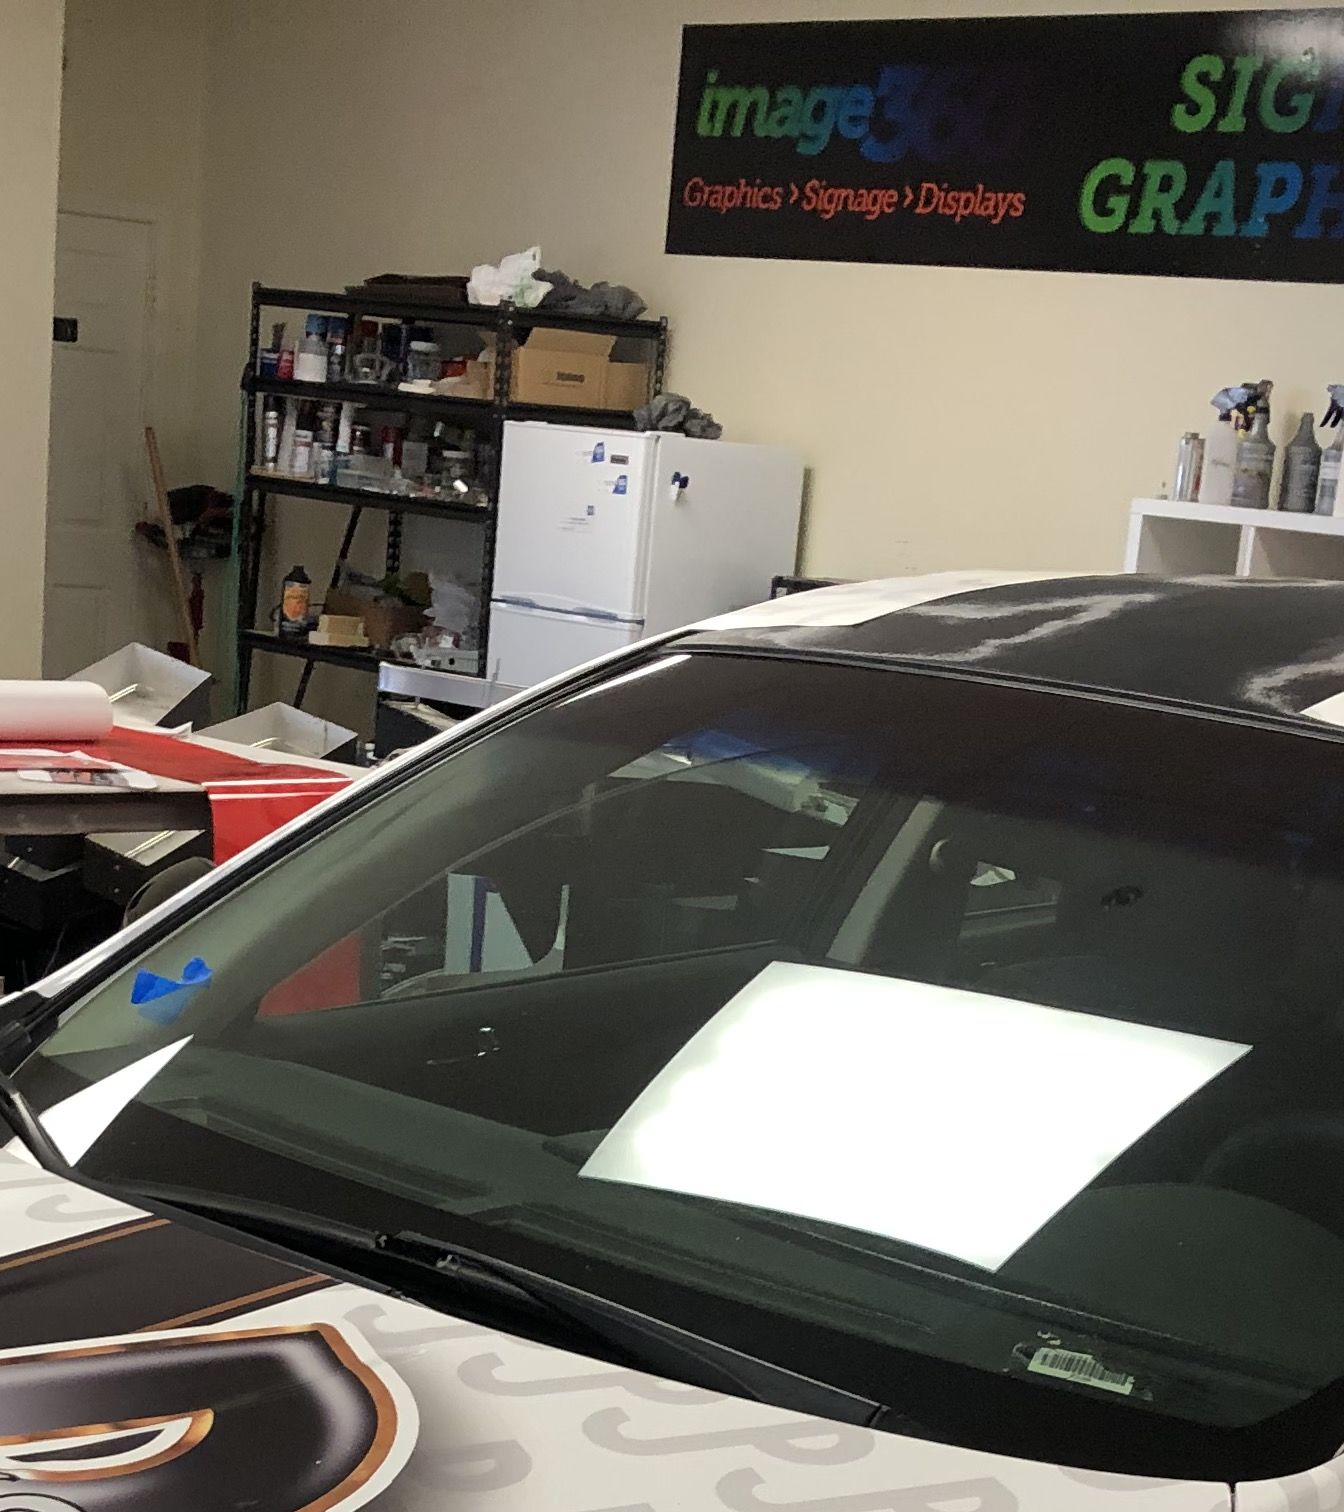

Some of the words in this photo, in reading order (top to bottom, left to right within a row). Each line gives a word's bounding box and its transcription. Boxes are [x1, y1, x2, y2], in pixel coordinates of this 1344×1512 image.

[683, 176, 785, 213] Graphics
[801, 179, 900, 221] Signage
[914, 182, 1026, 225] Displays
